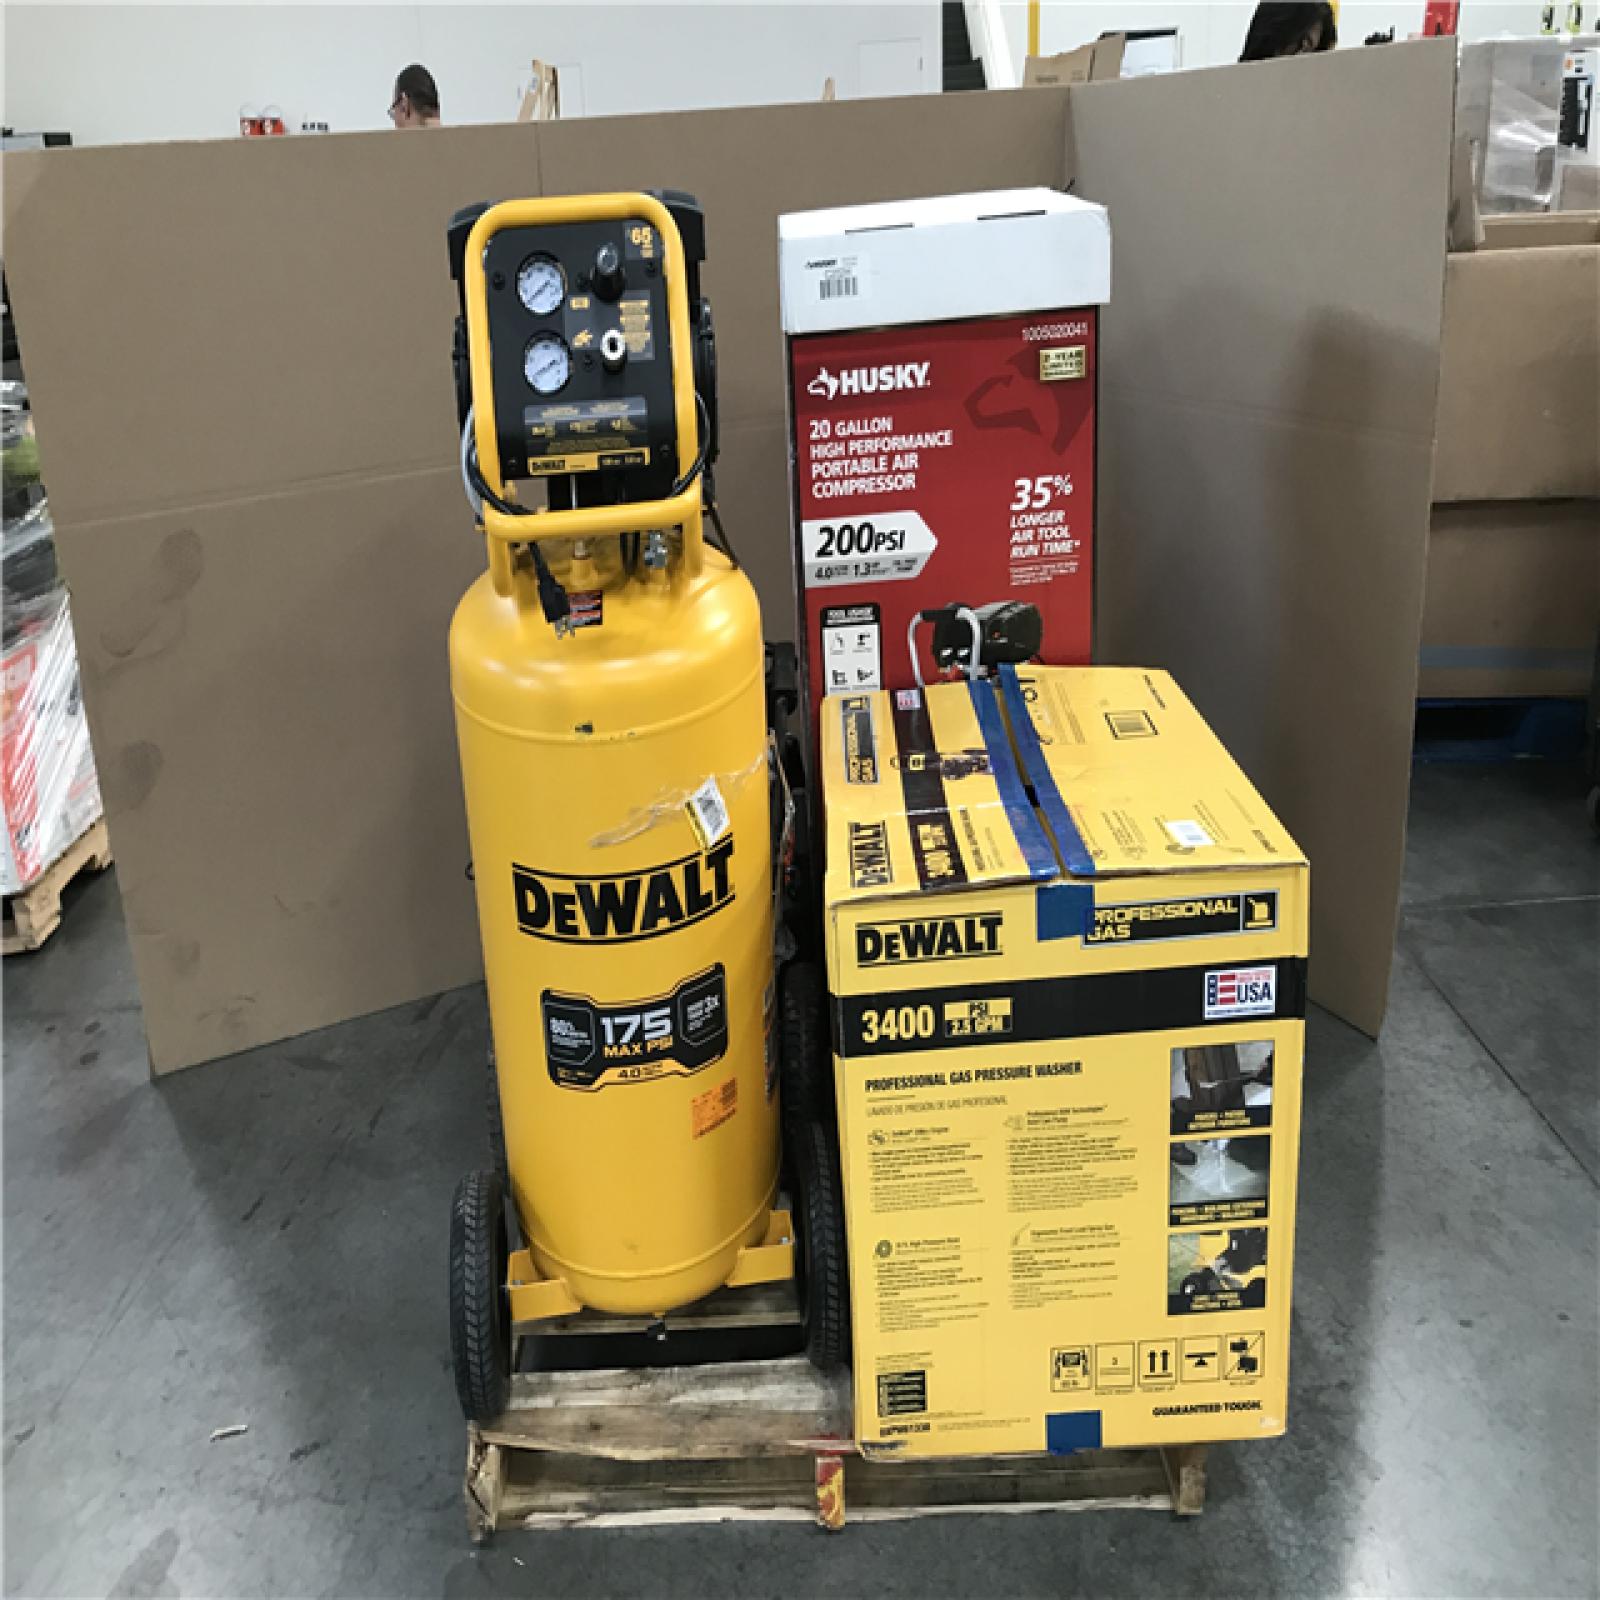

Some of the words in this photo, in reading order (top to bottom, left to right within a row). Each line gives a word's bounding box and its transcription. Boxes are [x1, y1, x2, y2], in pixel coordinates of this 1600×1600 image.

[840, 361, 930, 395] HUSKY
[809, 418, 831, 440] 20
[834, 416, 893, 437] GALLON
[809, 441, 846, 460] HIGH
[847, 429, 953, 456] PERFORMANCE
[811, 455, 888, 480] PORTABLE
[891, 451, 919, 471] AIR
[811, 471, 916, 498] COMPRESSOR
[1009, 473, 1073, 511] 35%
[1009, 509, 1065, 529] LONGER
[1009, 529, 1035, 544] AIR
[1037, 524, 1070, 541] TOOL
[1009, 544, 1040, 559] RUN
[846, 820, 894, 888] DEWALT
[512, 839, 734, 937] DEWALT
[856, 916, 1003, 962] DEWALT
[1237, 982, 1272, 1004] USA
[601, 1007, 672, 1045] 175
[861, 1004, 935, 1043] 3400
[604, 1042, 644, 1059] MAX
[864, 1072, 948, 1093] PROFESSIONAL
[949, 1069, 973, 1084] GAS
[974, 1064, 1033, 1081] PRESSURE
[1034, 1060, 1083, 1077] WASHER
[1152, 1402, 1221, 1417] GUARANTEED
